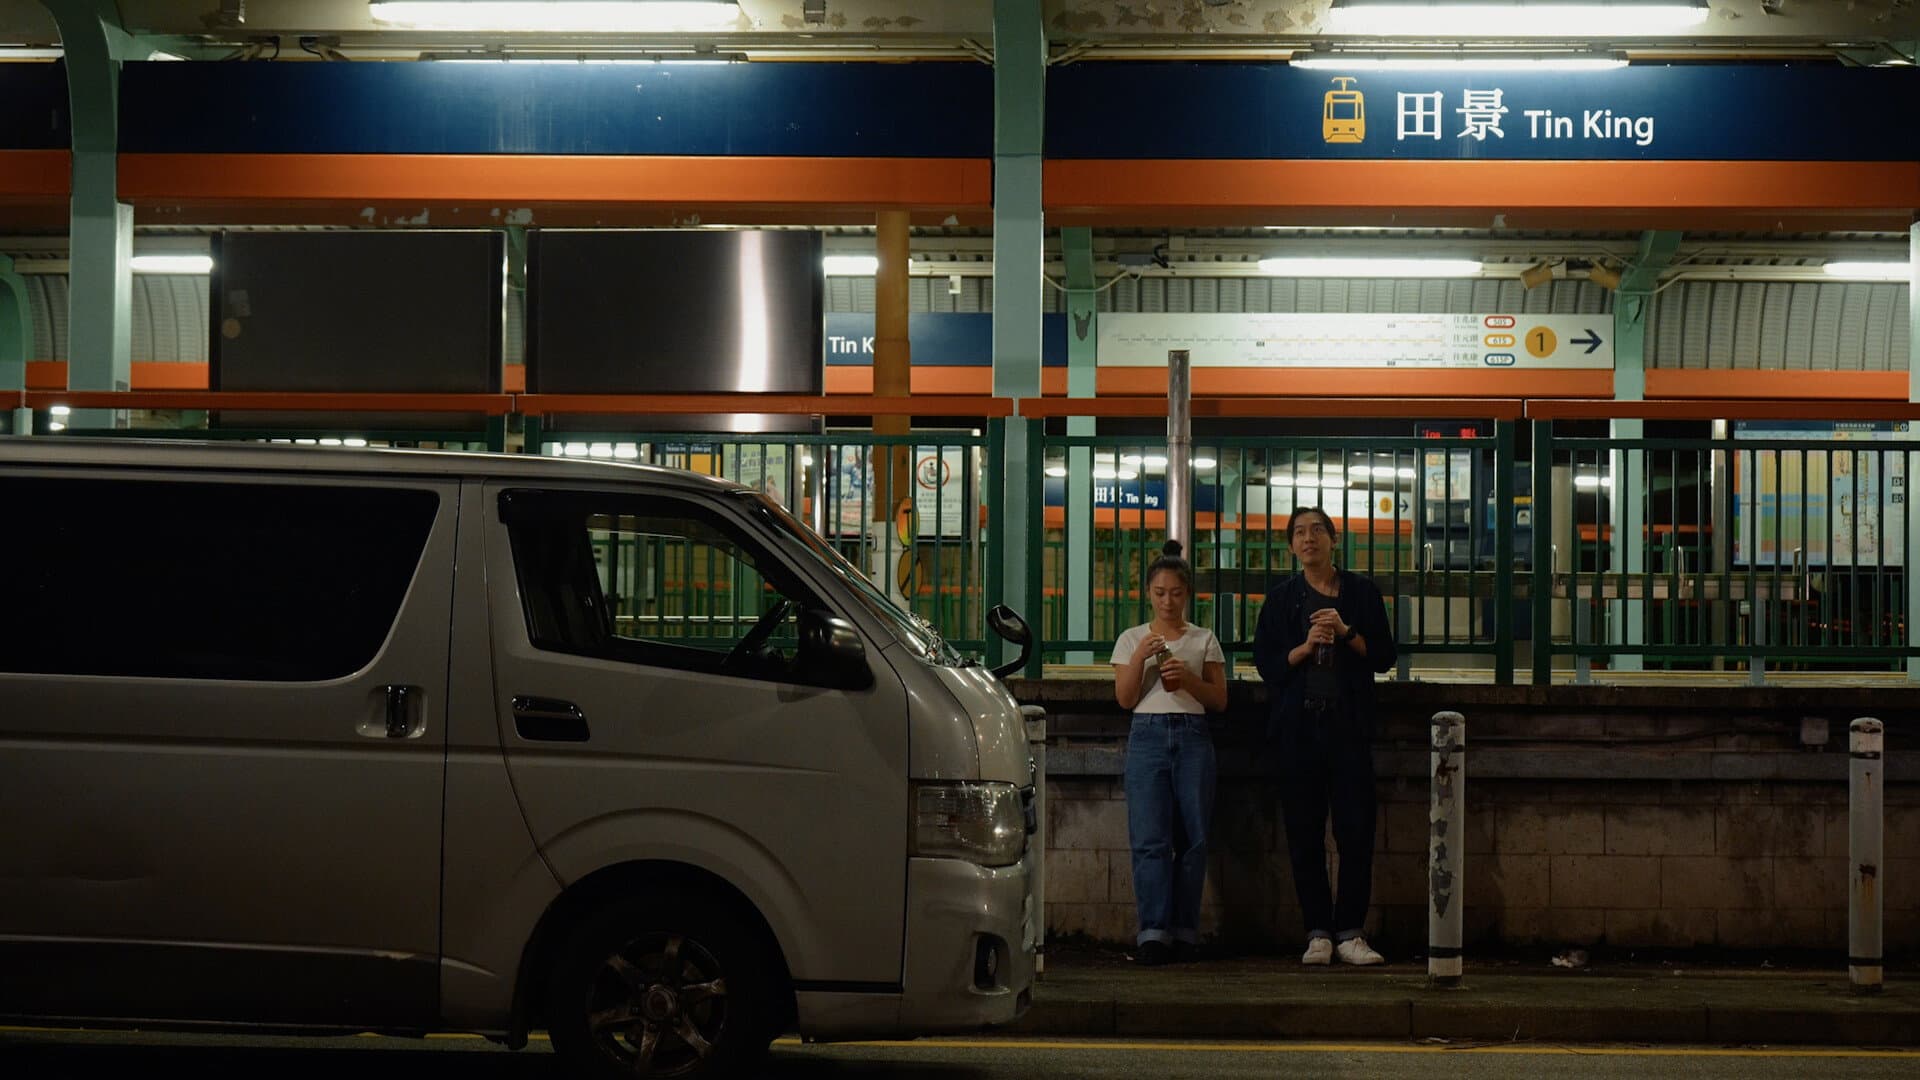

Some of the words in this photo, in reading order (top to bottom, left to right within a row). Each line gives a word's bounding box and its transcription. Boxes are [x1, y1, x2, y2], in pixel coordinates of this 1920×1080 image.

[1397, 88, 1509, 140] 田景
[1524, 110, 1573, 139] Tin
[1583, 110, 1654, 146] King
[828, 336, 857, 353] Tin
[1536, 332, 1544, 352] 1
[1126, 493, 1140, 504] Tin
[1143, 494, 1158, 507] ing
